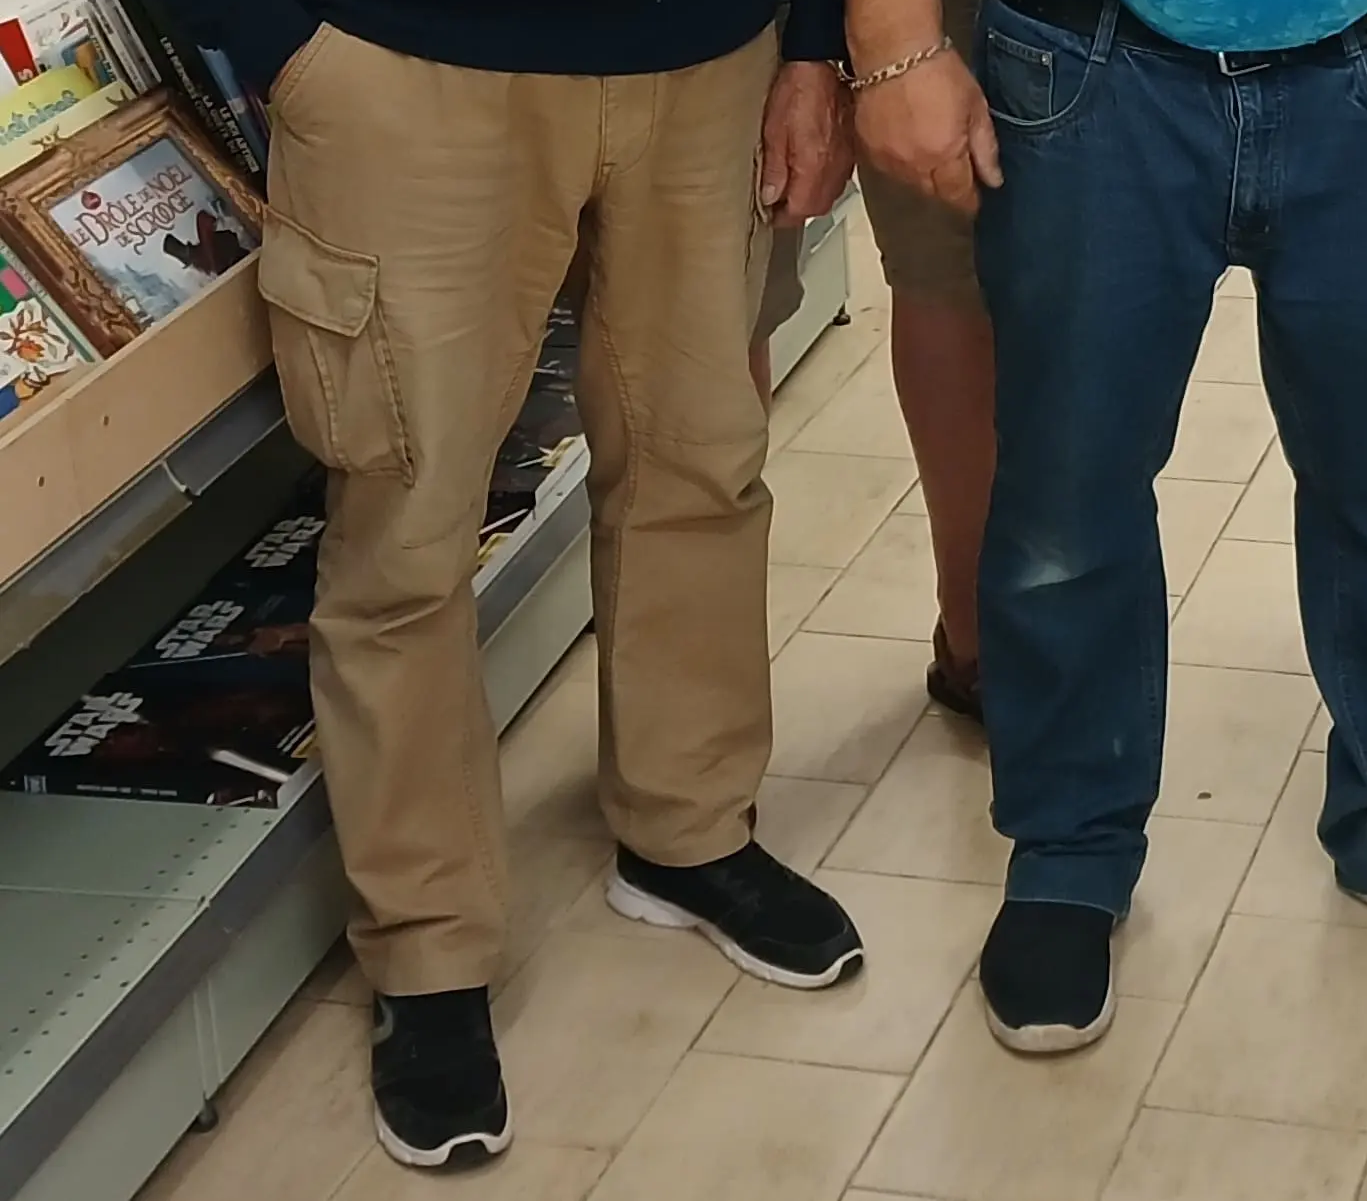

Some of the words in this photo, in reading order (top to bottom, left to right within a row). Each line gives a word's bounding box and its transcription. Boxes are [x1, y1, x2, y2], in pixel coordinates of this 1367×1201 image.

[72, 228, 91, 247] LE
[126, 189, 195, 256] SCROOGE
[244, 516, 316, 561] STAR
[155, 600, 236, 650] STAR
[159, 604, 245, 659] WARS
[44, 692, 134, 747] STAR
[49, 697, 144, 757] WARS
